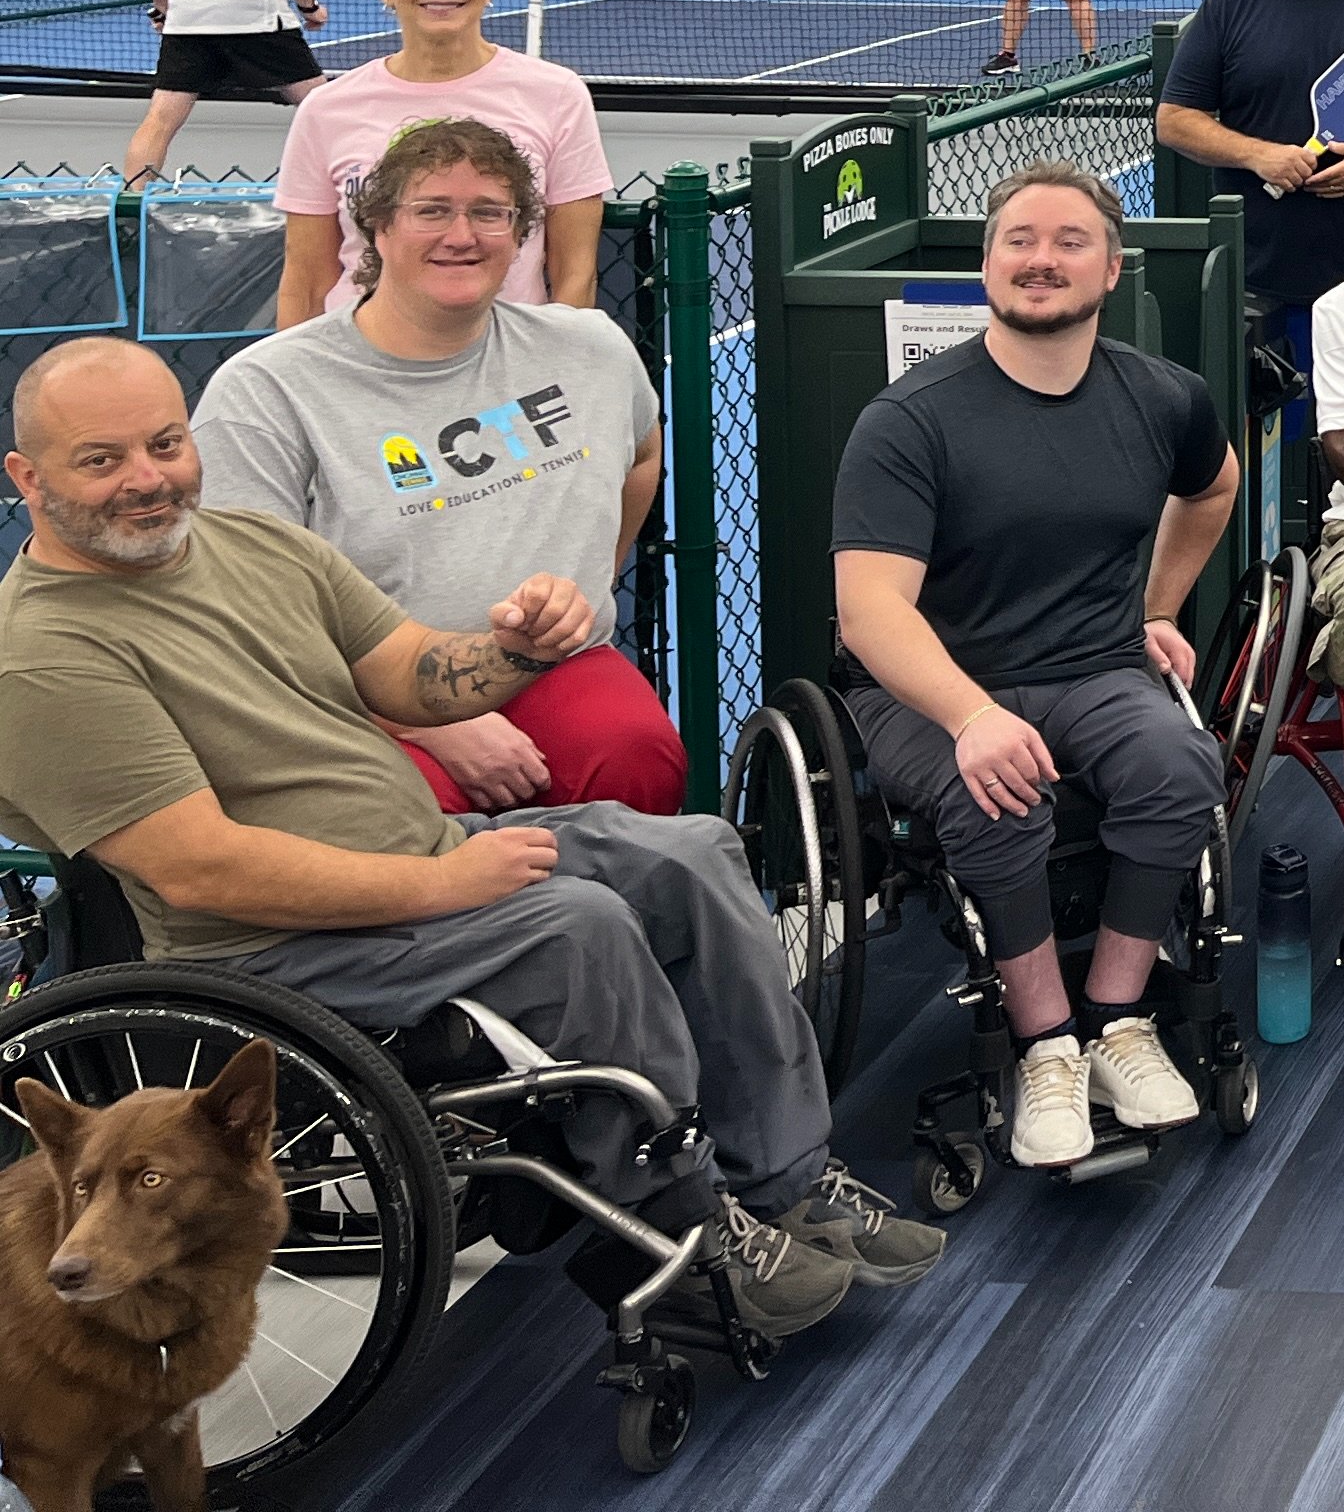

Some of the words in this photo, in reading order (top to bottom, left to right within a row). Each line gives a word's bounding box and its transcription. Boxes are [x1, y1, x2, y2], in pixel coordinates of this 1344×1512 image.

[803, 139, 834, 172] PIZZA
[835, 128, 868, 152] BOXES
[869, 127, 894, 145] ONLY
[902, 324, 933, 332] Draws
[937, 325, 954, 333] and
[438, 384, 572, 478] CTF
[400, 501, 433, 517] LOVE
[447, 475, 522, 507] EDUCATION
[541, 449, 584, 474] TENNIS
